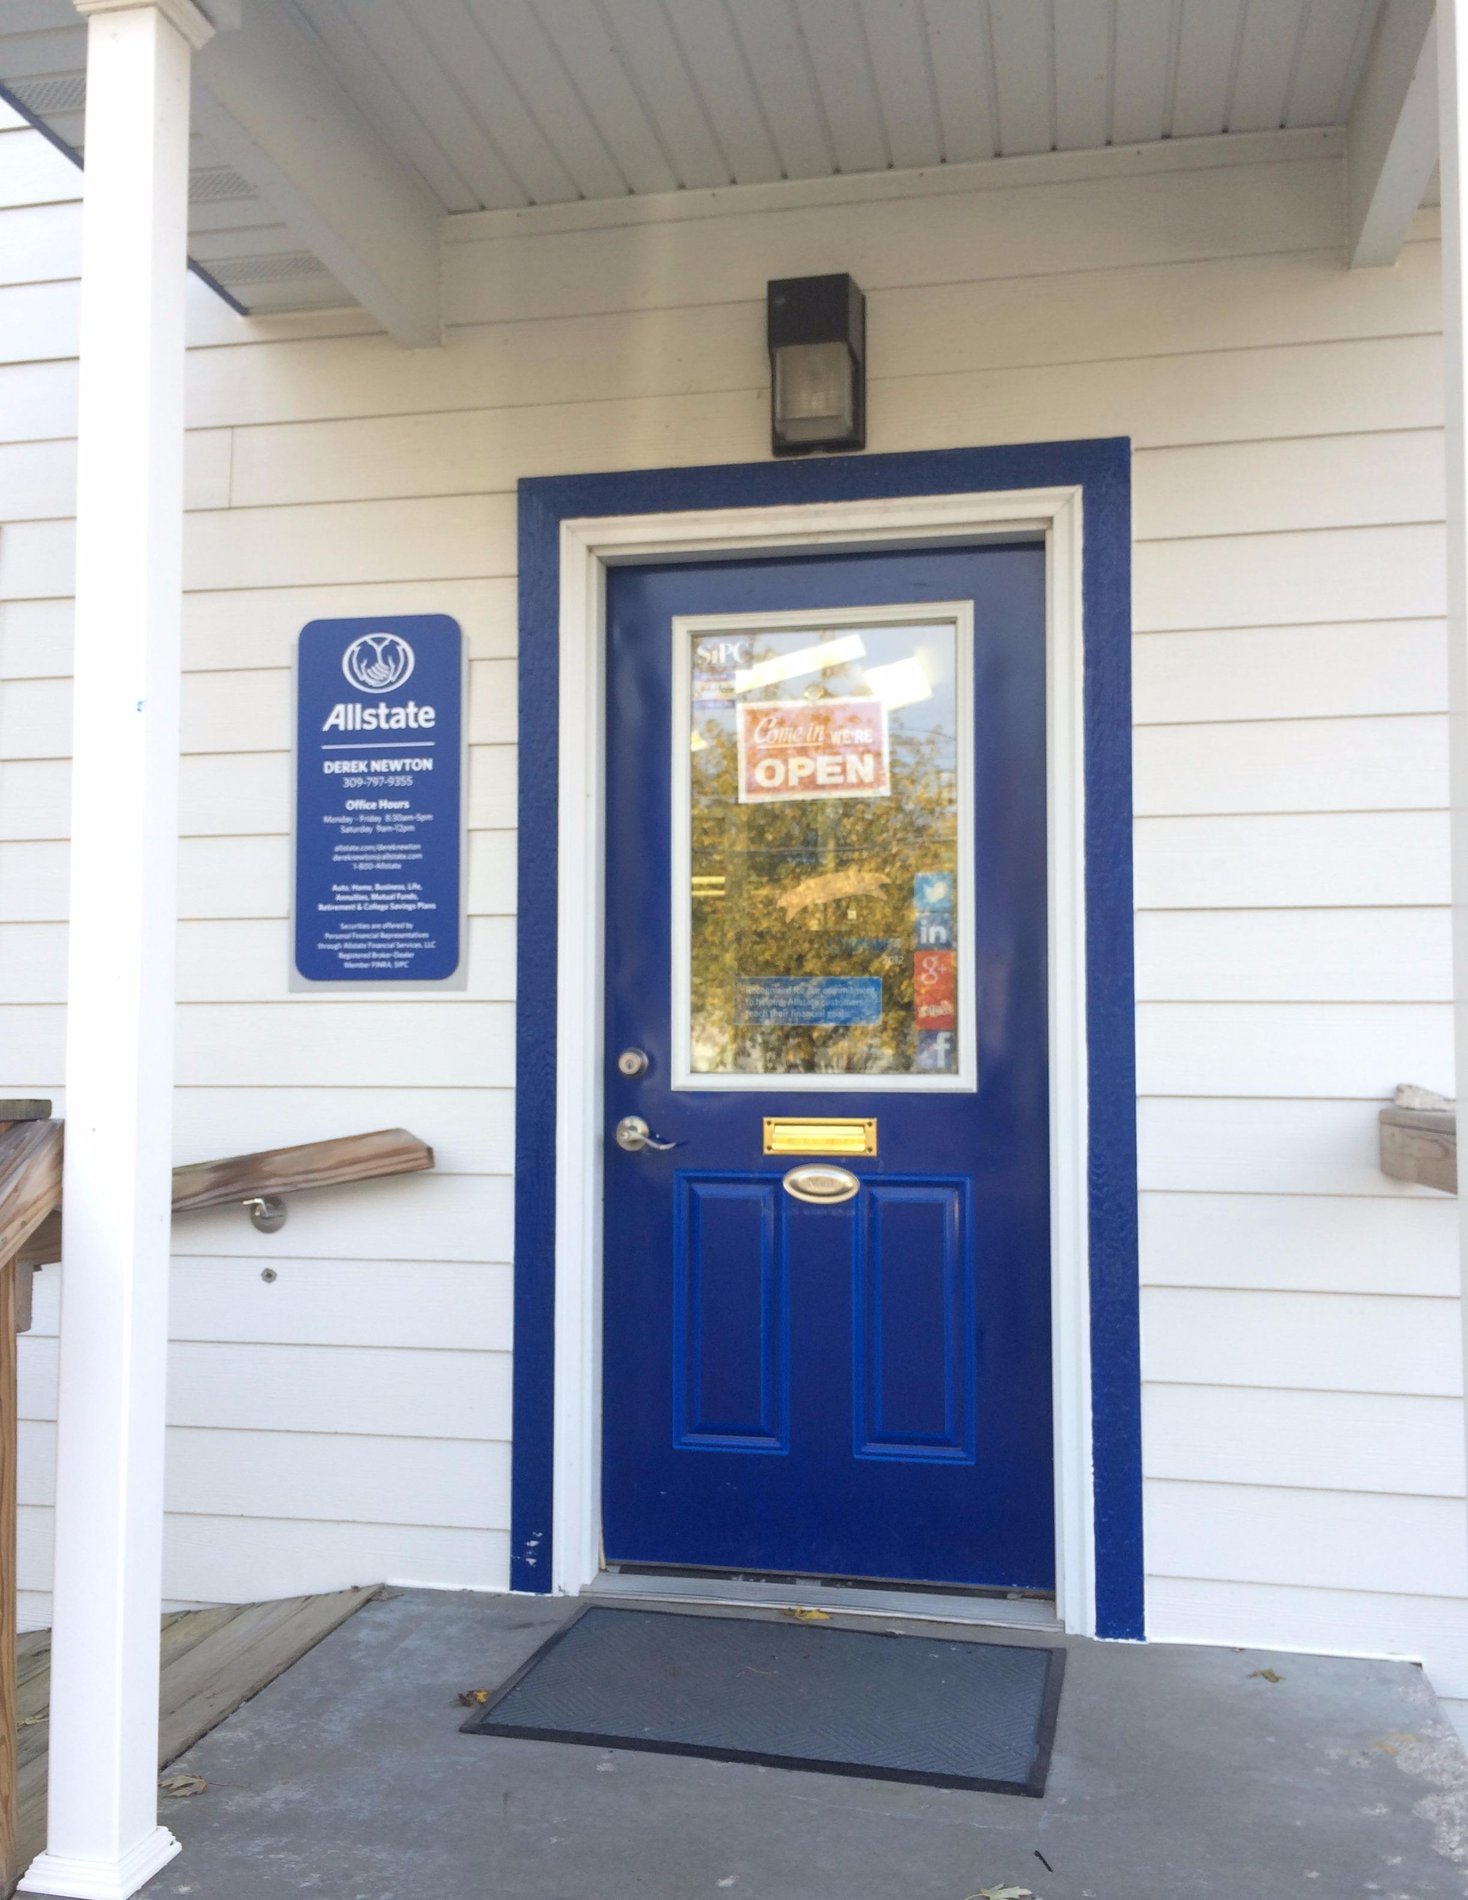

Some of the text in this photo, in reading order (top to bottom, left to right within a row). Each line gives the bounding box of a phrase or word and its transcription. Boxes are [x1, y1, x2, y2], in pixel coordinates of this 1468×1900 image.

[321, 701, 436, 731] Allstate
[753, 716, 873, 744] Come in WE'RE
[323, 758, 433, 774] DEREK NEWTON
[754, 753, 875, 788] OPEN
[343, 776, 414, 788] 309-797-9355
[345, 800, 410, 811] Office Hours
[323, 815, 354, 824] Monday
[360, 814, 382, 823] Friday
[340, 825, 373, 834] Saturday
[920, 920, 947, 944] in
